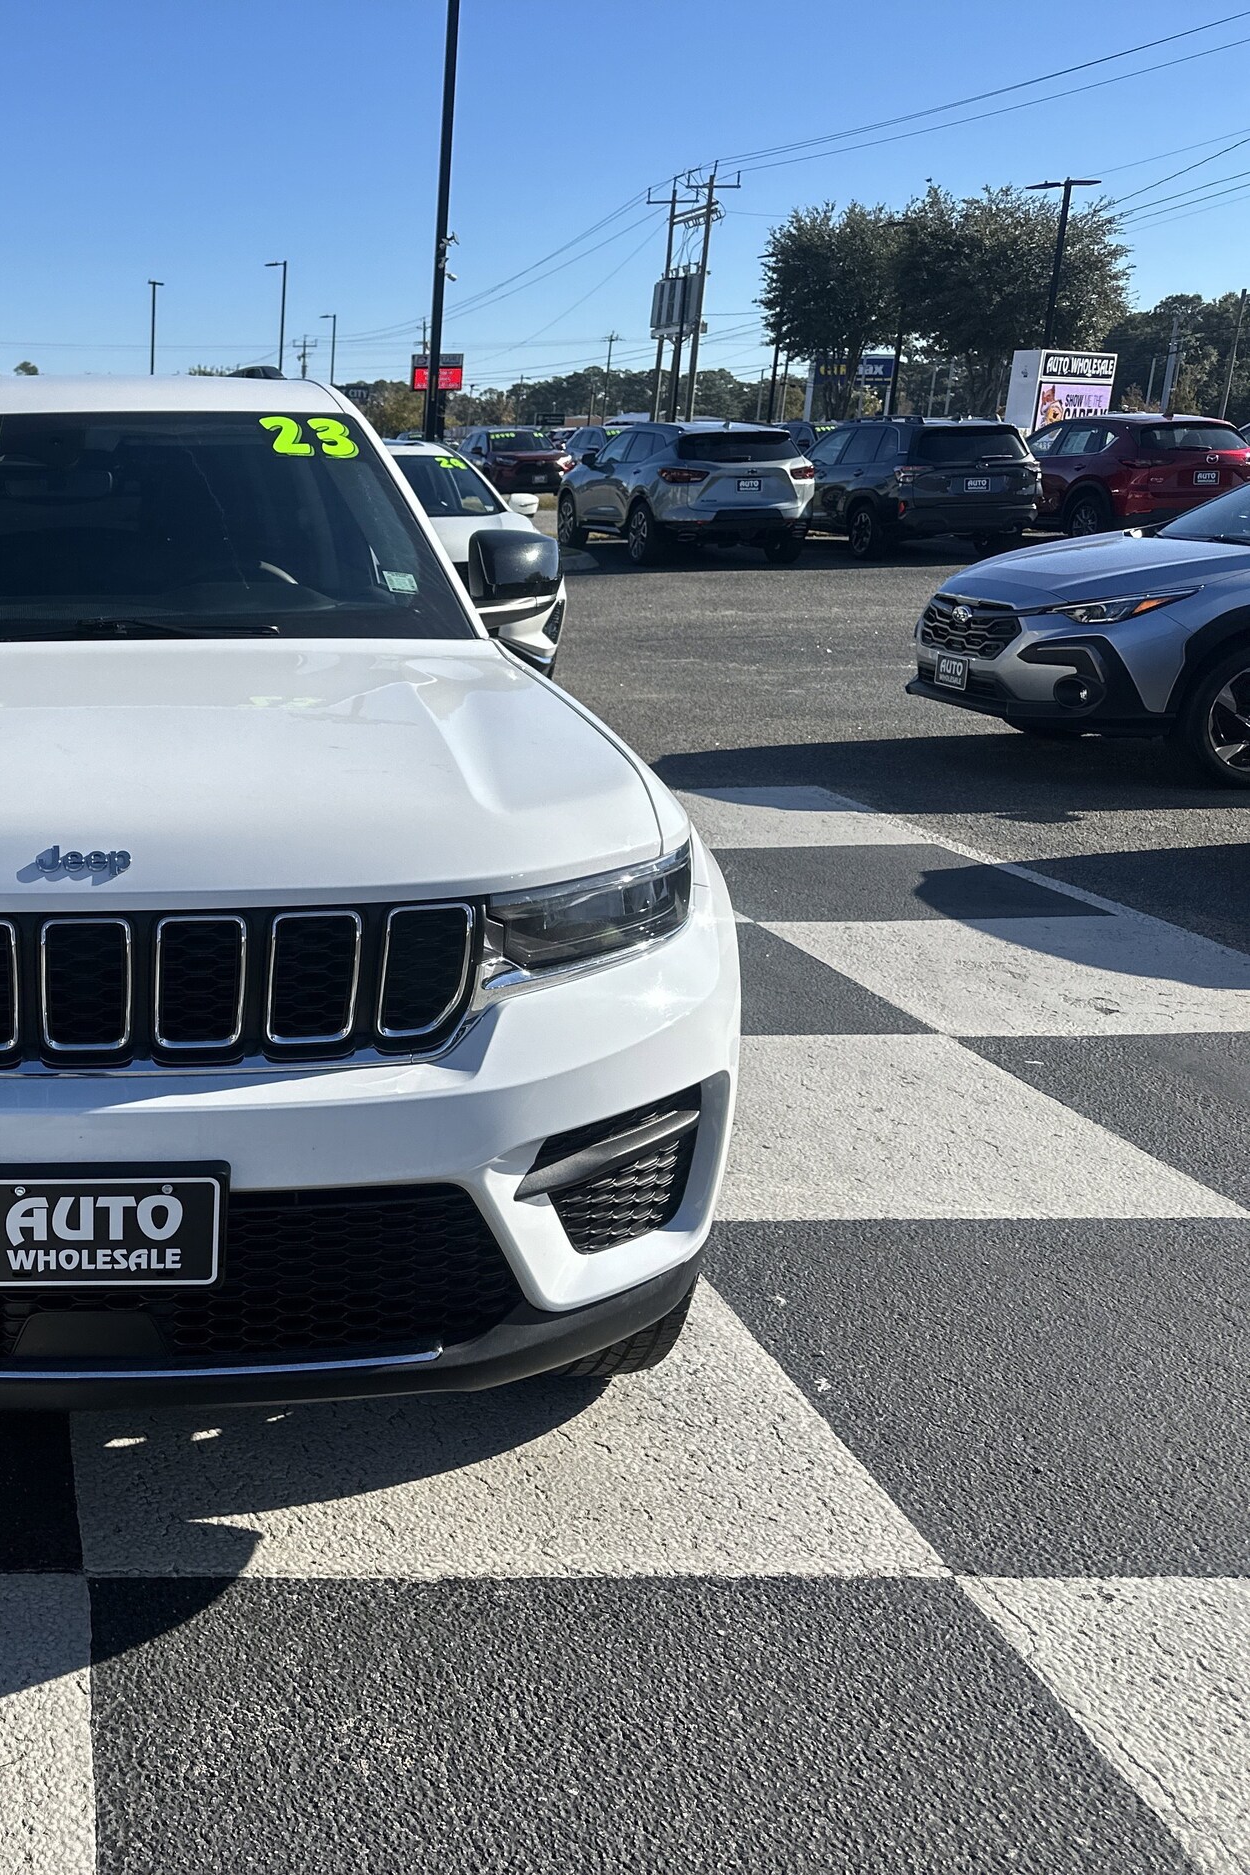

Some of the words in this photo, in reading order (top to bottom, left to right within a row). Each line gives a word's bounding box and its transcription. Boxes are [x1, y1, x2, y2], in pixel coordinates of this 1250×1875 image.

[1046, 356, 1070, 375] AUTO
[1071, 357, 1114, 376] WHOLESALE
[1065, 394, 1084, 407] SHOW
[258, 416, 360, 459] 23
[967, 479, 987, 487] AUTO
[1197, 472, 1216, 480] AUTO
[940, 658, 963, 676] AUTO
[35, 845, 131, 876] Jeep
[5, 1194, 183, 1247] AUTO
[6, 1248, 182, 1272] WHOLESALE
